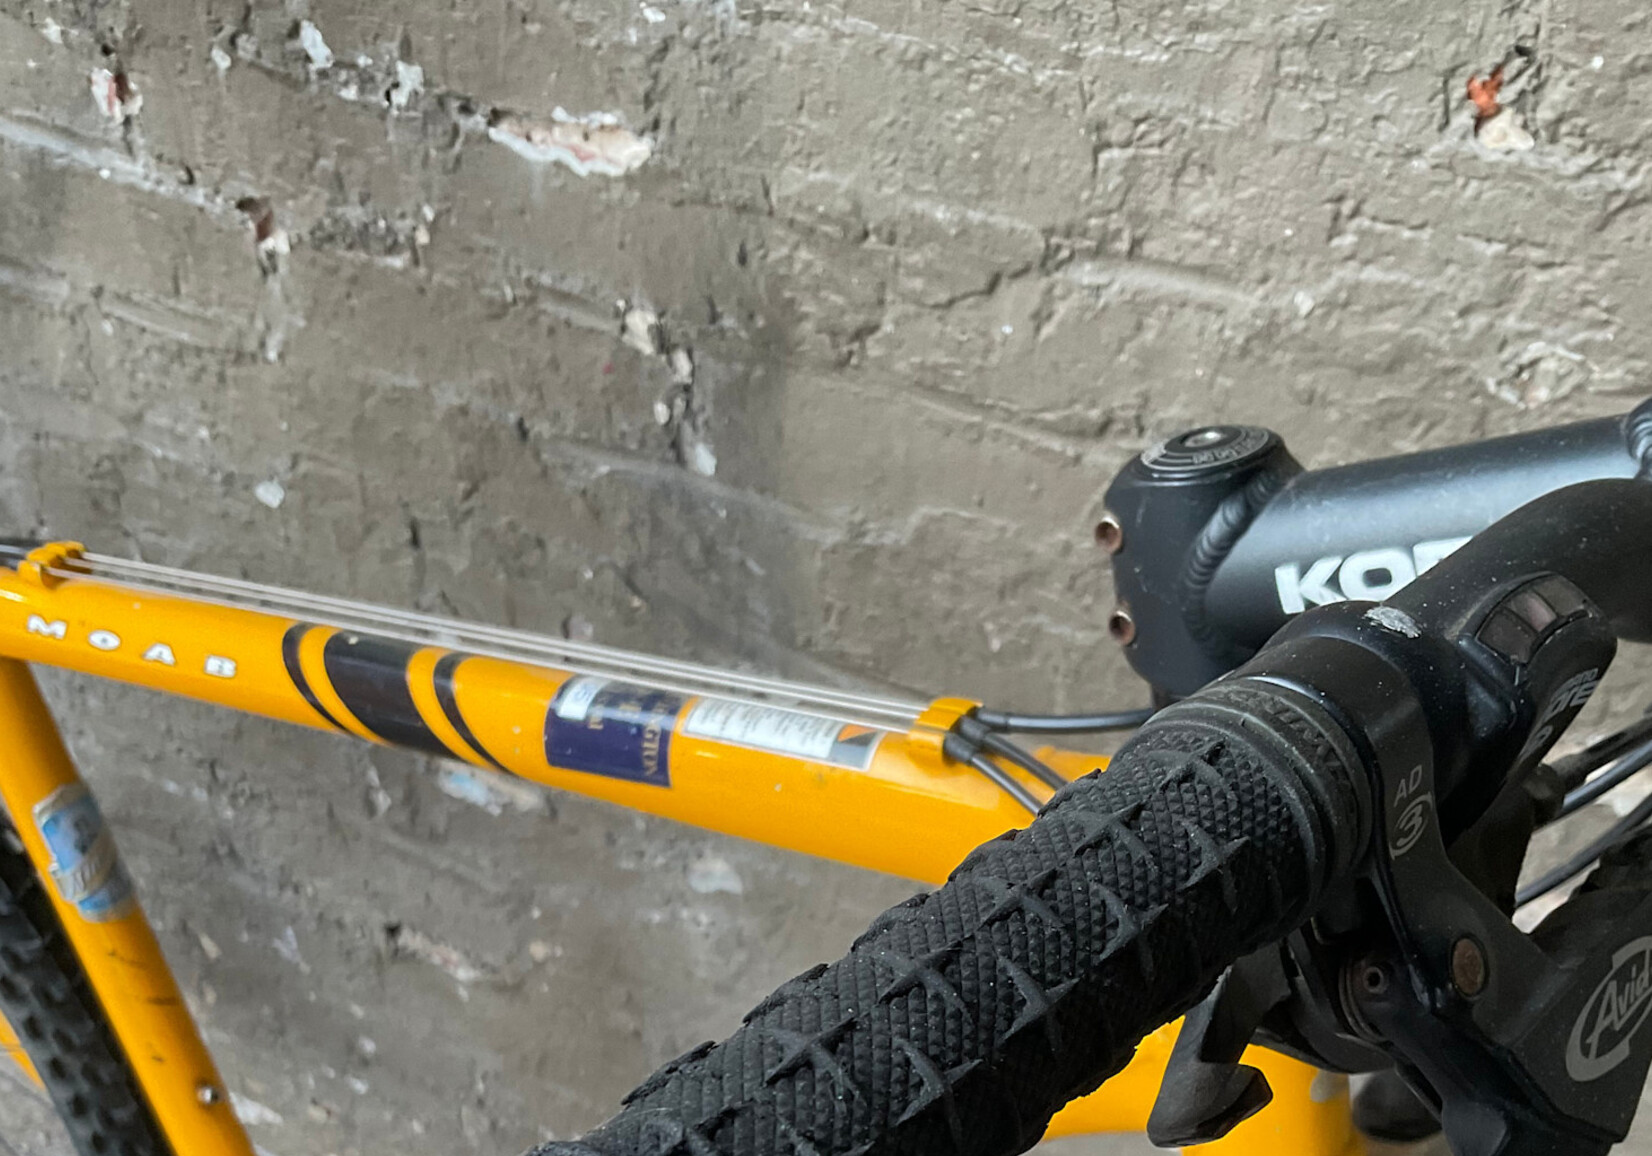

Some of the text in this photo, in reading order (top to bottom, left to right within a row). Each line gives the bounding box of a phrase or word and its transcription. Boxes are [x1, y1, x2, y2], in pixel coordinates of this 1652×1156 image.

[27, 613, 238, 679] MOAB
[1393, 764, 1423, 807] AD
[1585, 950, 1650, 1060] Avid
